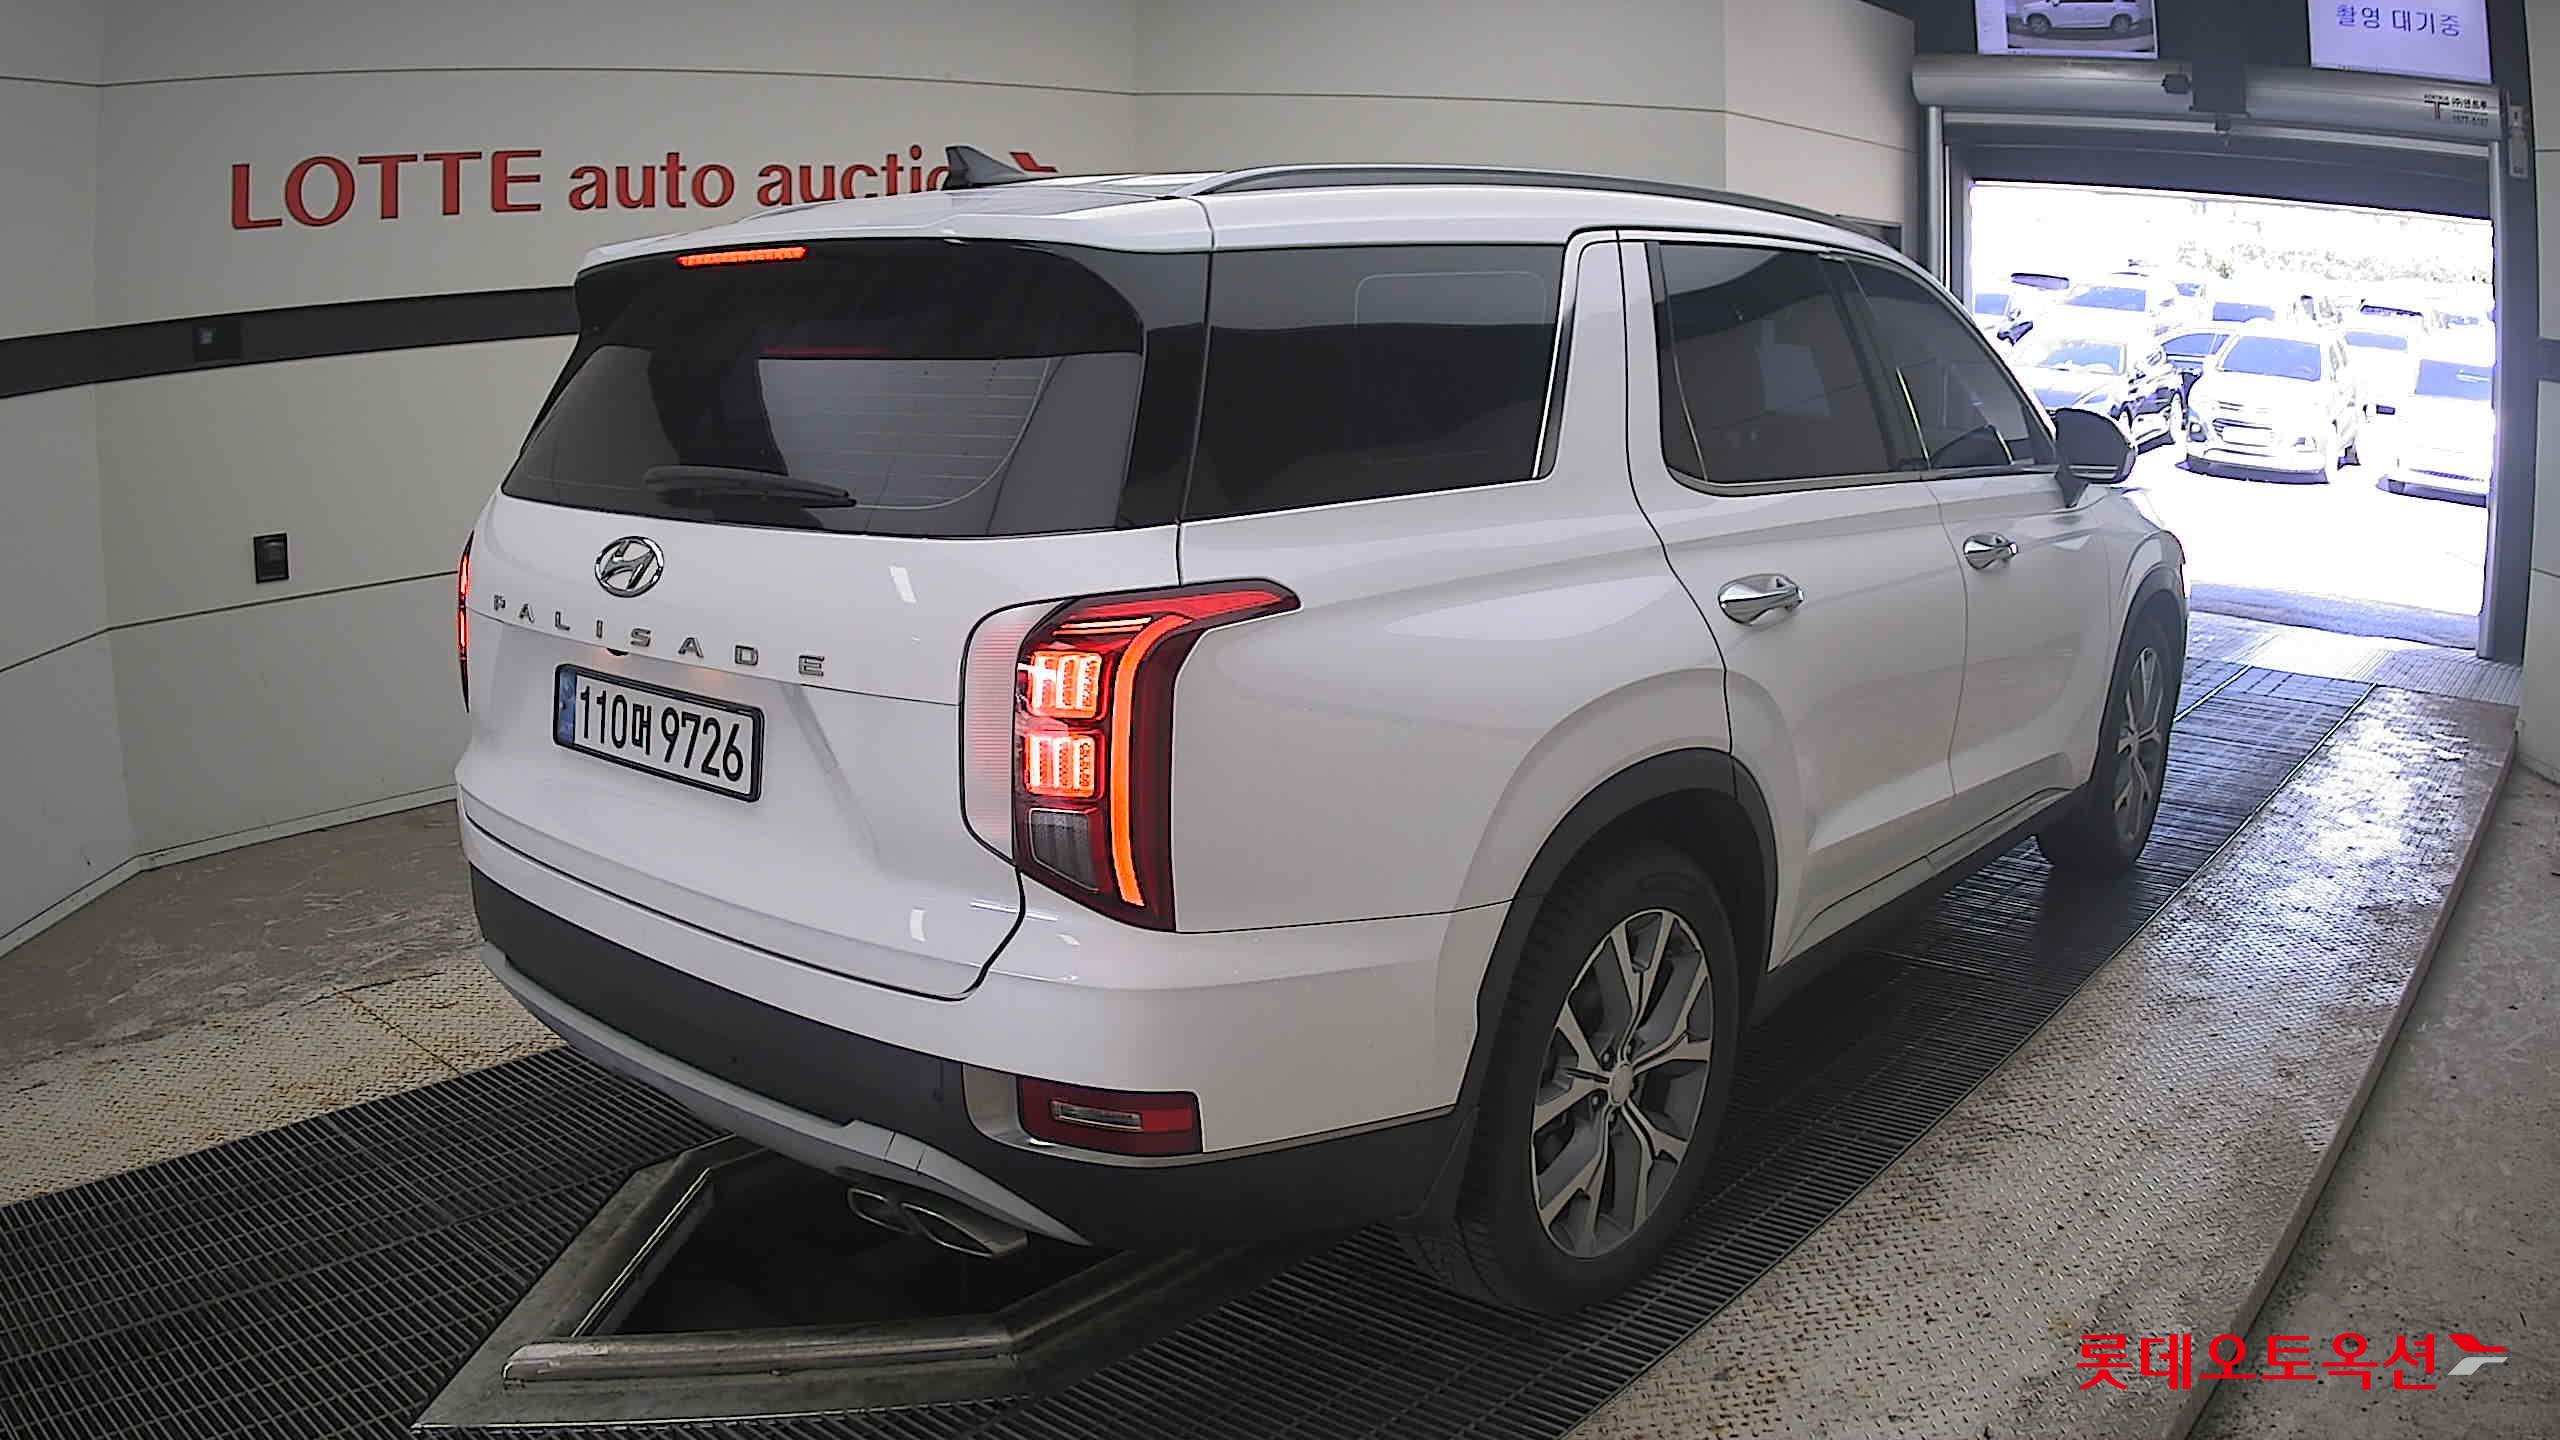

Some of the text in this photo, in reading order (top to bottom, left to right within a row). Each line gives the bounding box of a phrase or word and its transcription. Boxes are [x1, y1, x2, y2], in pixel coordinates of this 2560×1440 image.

[2336, 4, 2461, 38] 촬영 대기중
[231, 149, 542, 230] LOTTE
[569, 152, 736, 210] auto
[493, 594, 826, 677] PALISADE
[579, 684, 744, 782] 110머 9726
